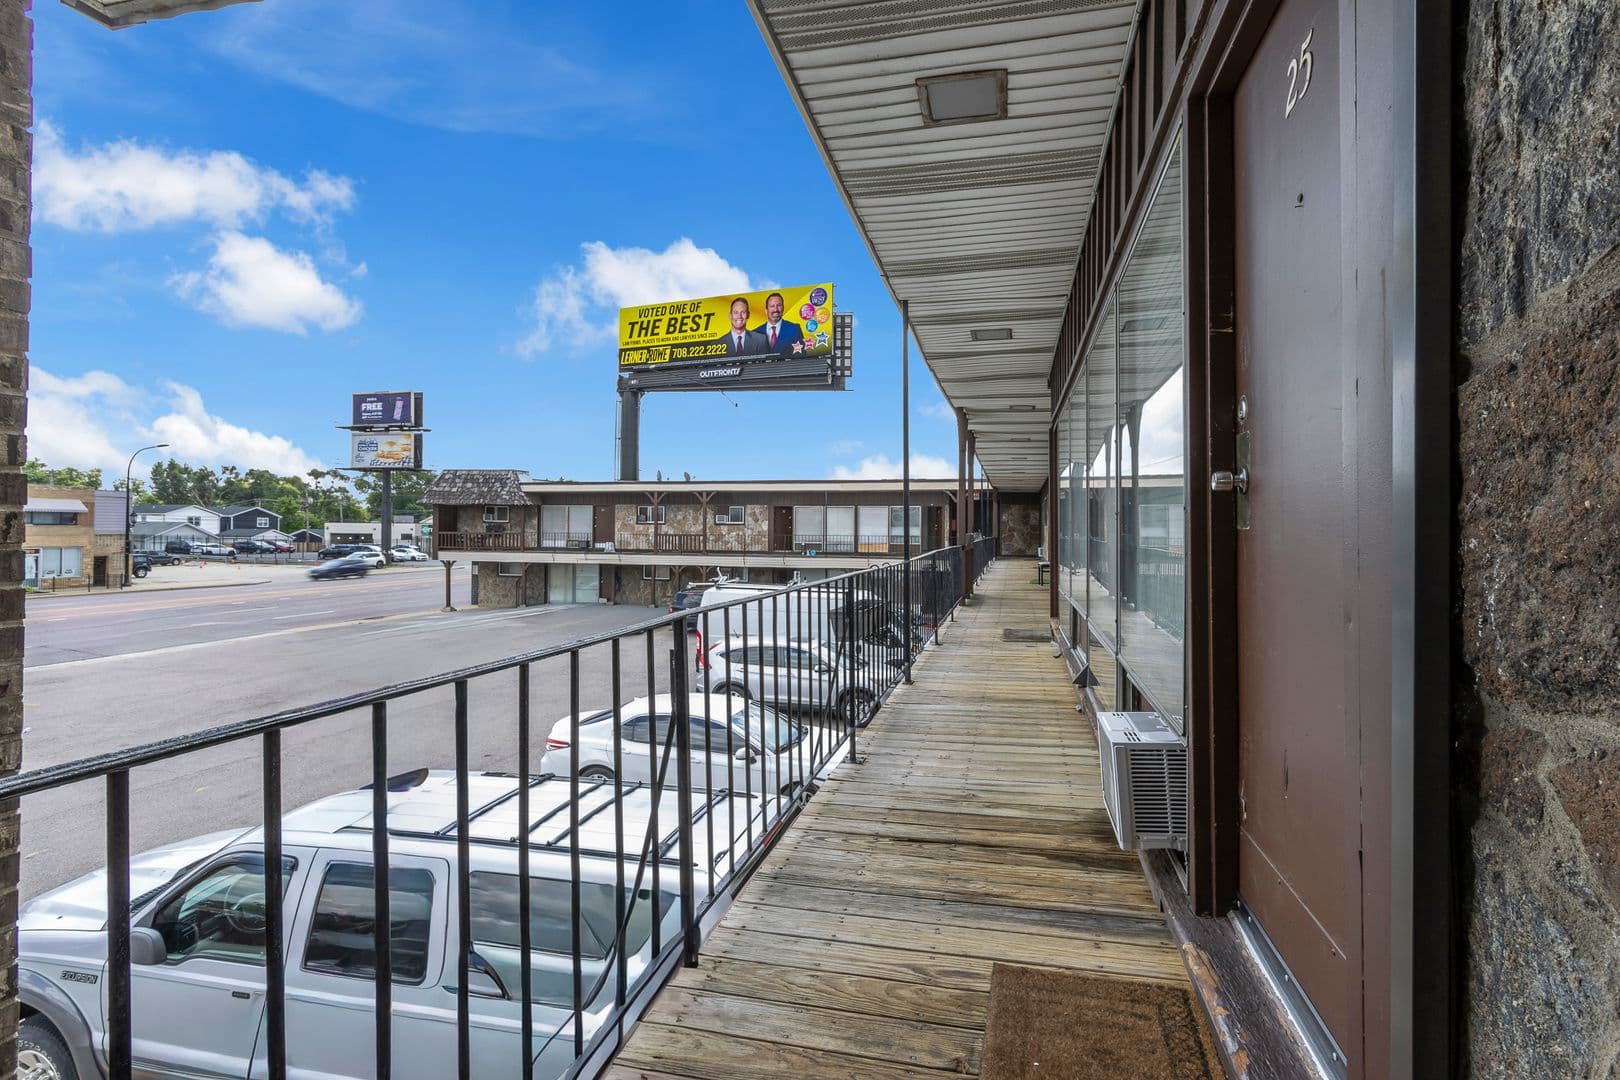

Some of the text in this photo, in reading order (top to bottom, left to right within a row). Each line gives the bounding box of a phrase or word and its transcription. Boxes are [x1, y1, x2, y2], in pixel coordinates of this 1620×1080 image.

[1285, 27, 1314, 119] 25
[638, 301, 702, 319] VOTED ONE OF
[628, 312, 715, 339] THE BEST
[672, 344, 727, 359] 708.222.2222
[361, 402, 383, 411] FREE
